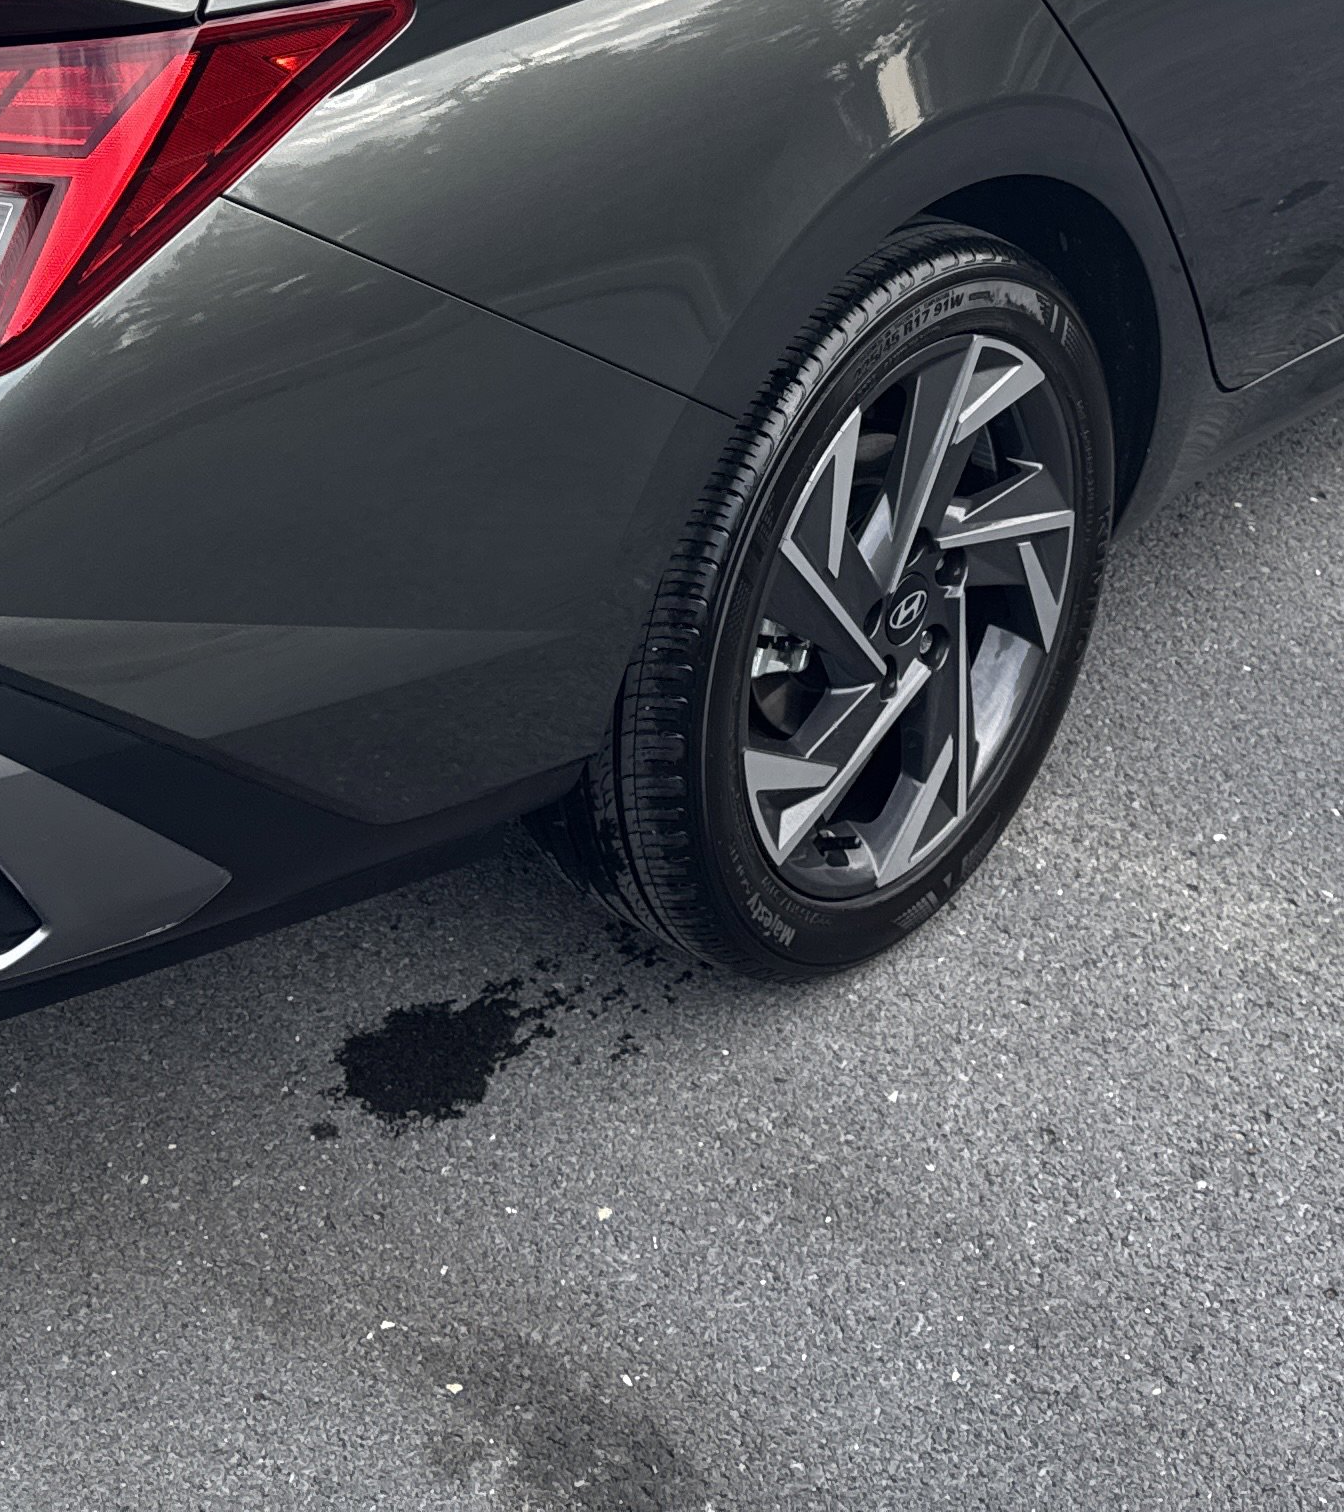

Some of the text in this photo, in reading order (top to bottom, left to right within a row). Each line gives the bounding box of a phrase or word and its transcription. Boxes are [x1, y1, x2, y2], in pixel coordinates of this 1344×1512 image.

[903, 308, 931, 337] R17
[934, 292, 964, 317] 91W
[746, 892, 796, 947] Majesty
